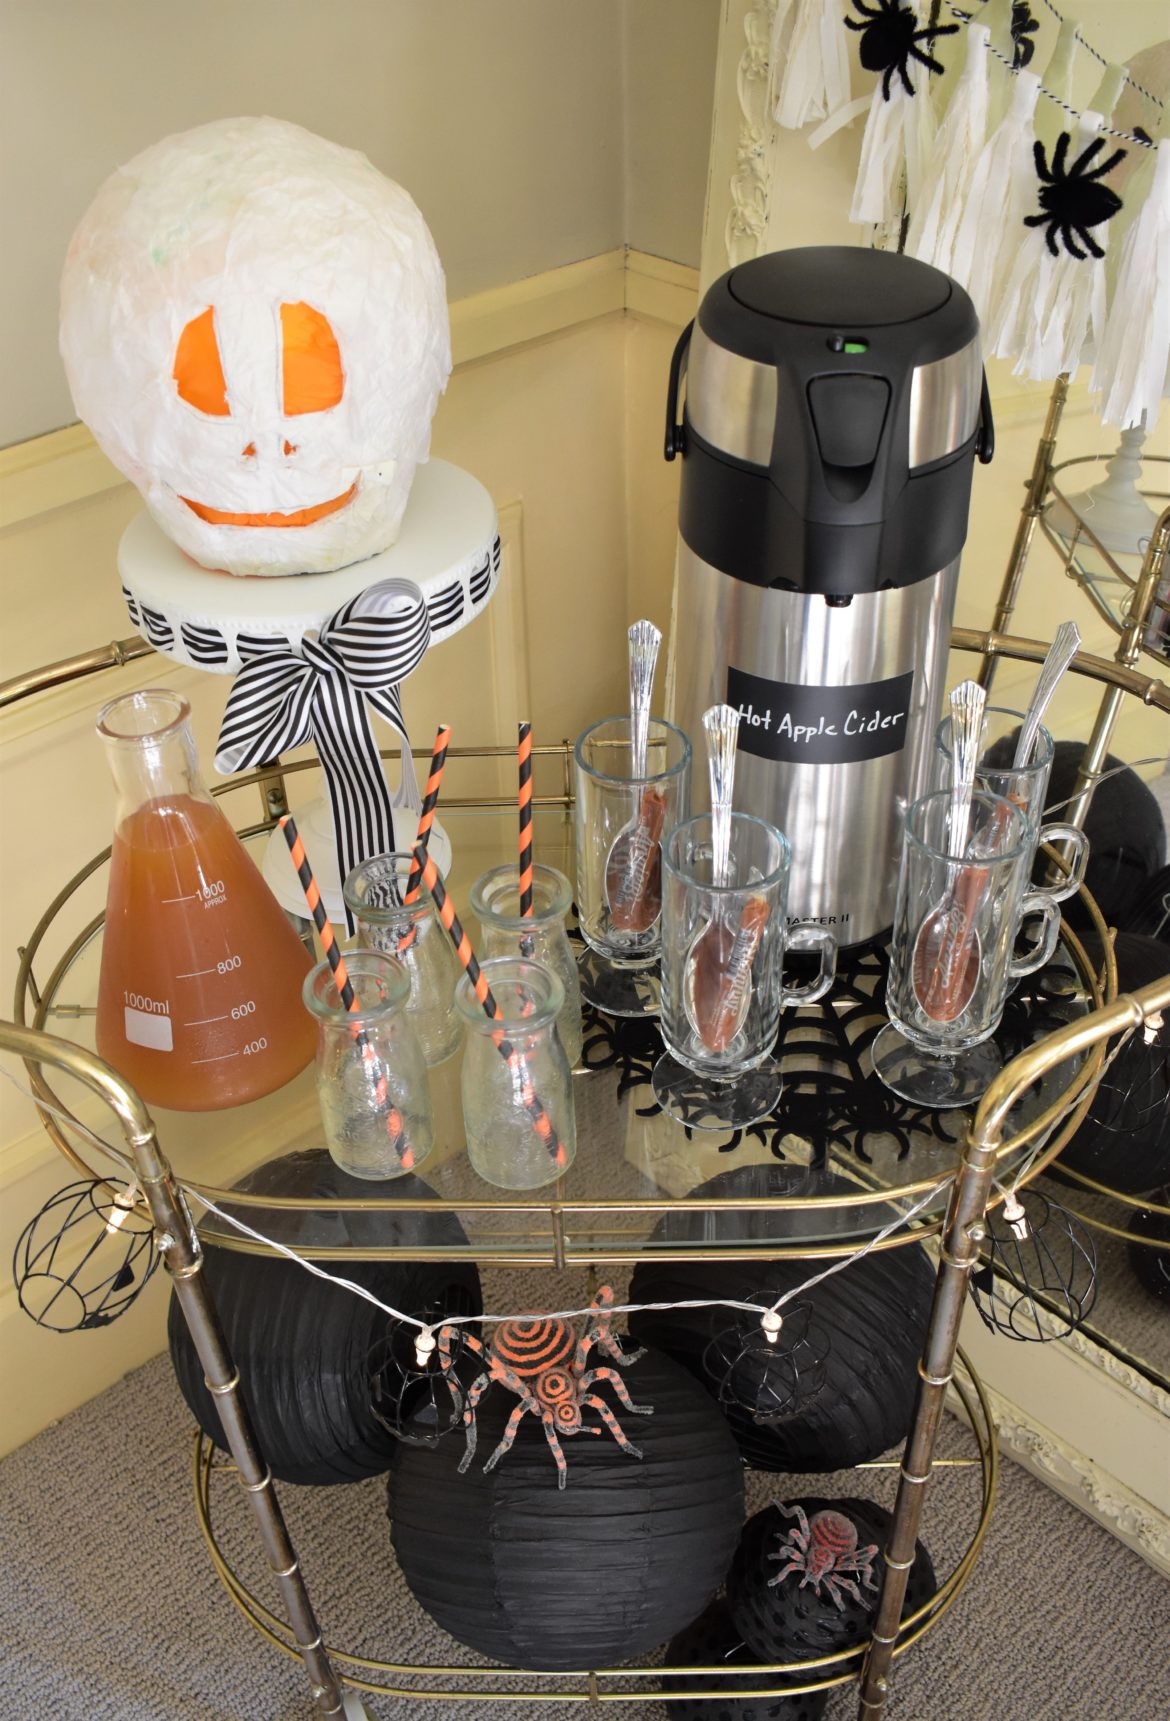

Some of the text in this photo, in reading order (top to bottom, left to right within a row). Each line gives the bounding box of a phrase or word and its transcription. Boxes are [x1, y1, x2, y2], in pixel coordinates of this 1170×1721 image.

[738, 703, 904, 743] Hot Apple Cider
[195, 880, 225, 901] 1000
[216, 955, 242, 975] 800
[123, 990, 170, 1015] 1000ml
[230, 1000, 256, 1020] 600
[242, 1037, 268, 1056] 400
